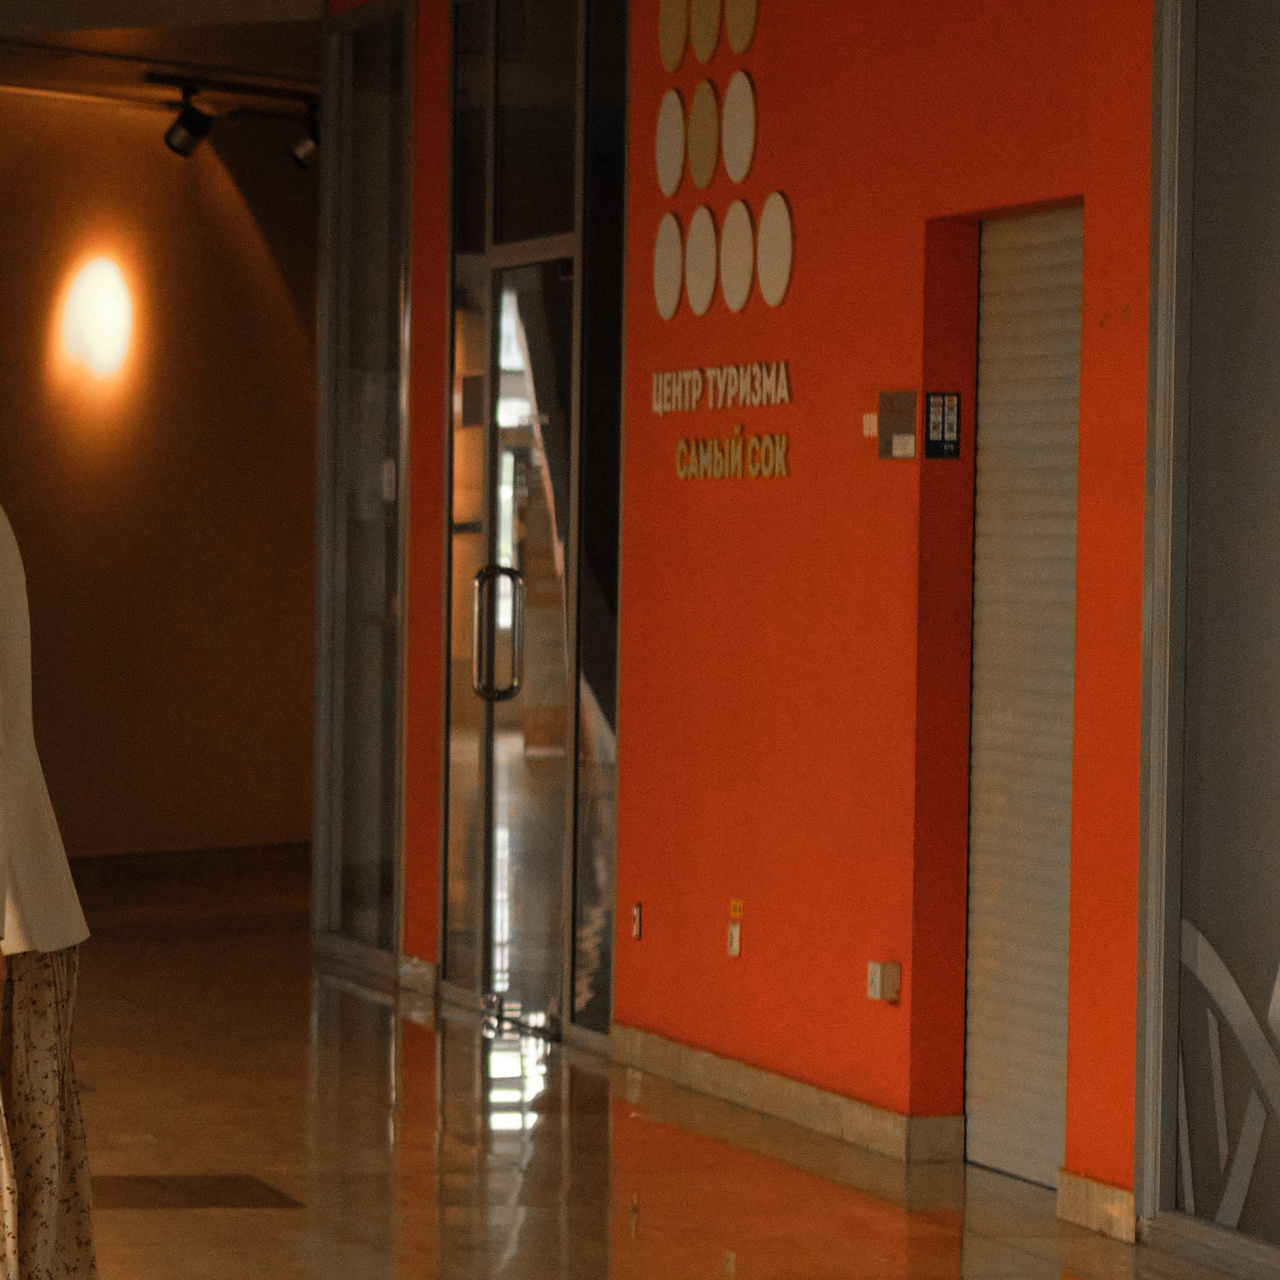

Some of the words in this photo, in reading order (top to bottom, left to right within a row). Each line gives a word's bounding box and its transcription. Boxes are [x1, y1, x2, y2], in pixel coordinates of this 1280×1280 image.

[652, 369, 703, 417] ЦЕНТР
[707, 361, 790, 410] ТУРИЗМА
[677, 424, 745, 480] САМЫЙ
[748, 434, 789, 478] СОК
